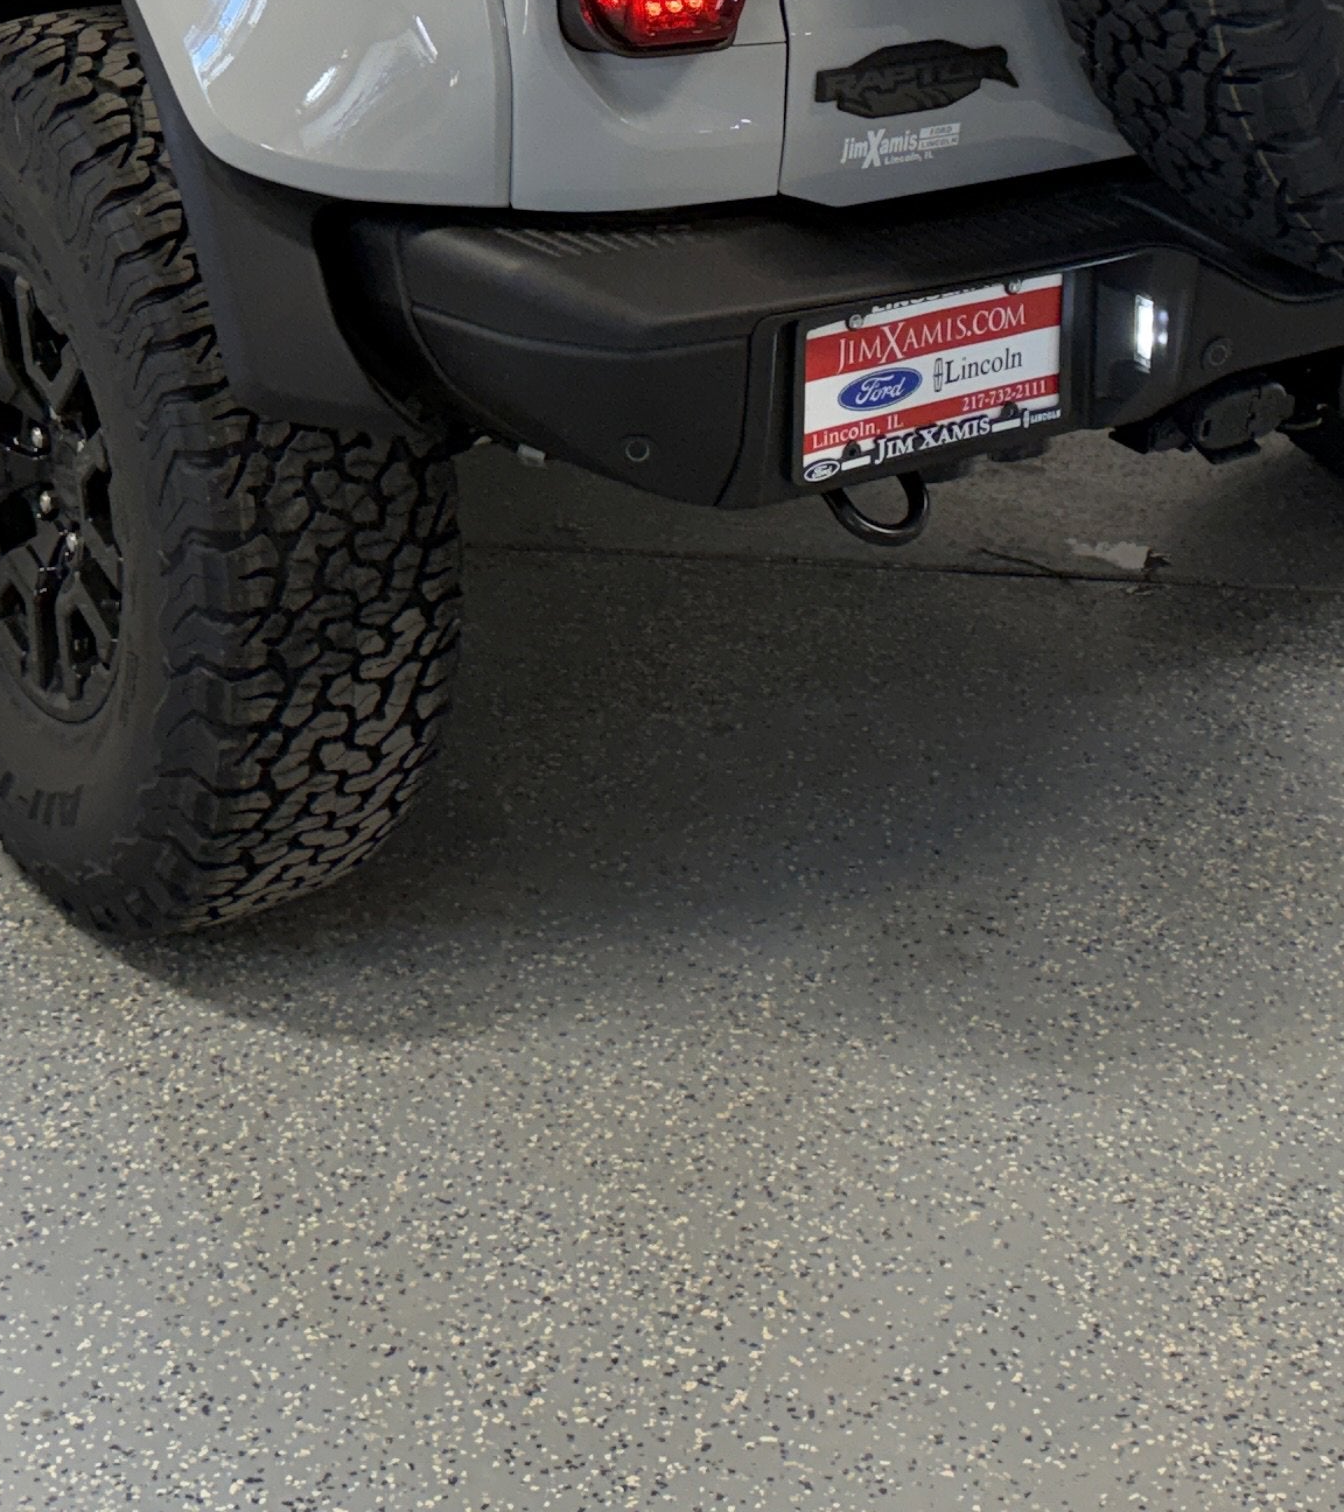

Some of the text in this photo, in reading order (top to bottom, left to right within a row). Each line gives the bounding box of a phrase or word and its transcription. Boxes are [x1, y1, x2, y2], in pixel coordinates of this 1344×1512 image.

[837, 303, 1026, 374] JIMXAMIS.COM
[945, 348, 1022, 385] Lincoln
[855, 374, 906, 405] Ford
[962, 379, 1047, 412] 217-732-2111
[812, 413, 904, 450] Lincoln, IL
[874, 417, 991, 465] JIM XAMIS
